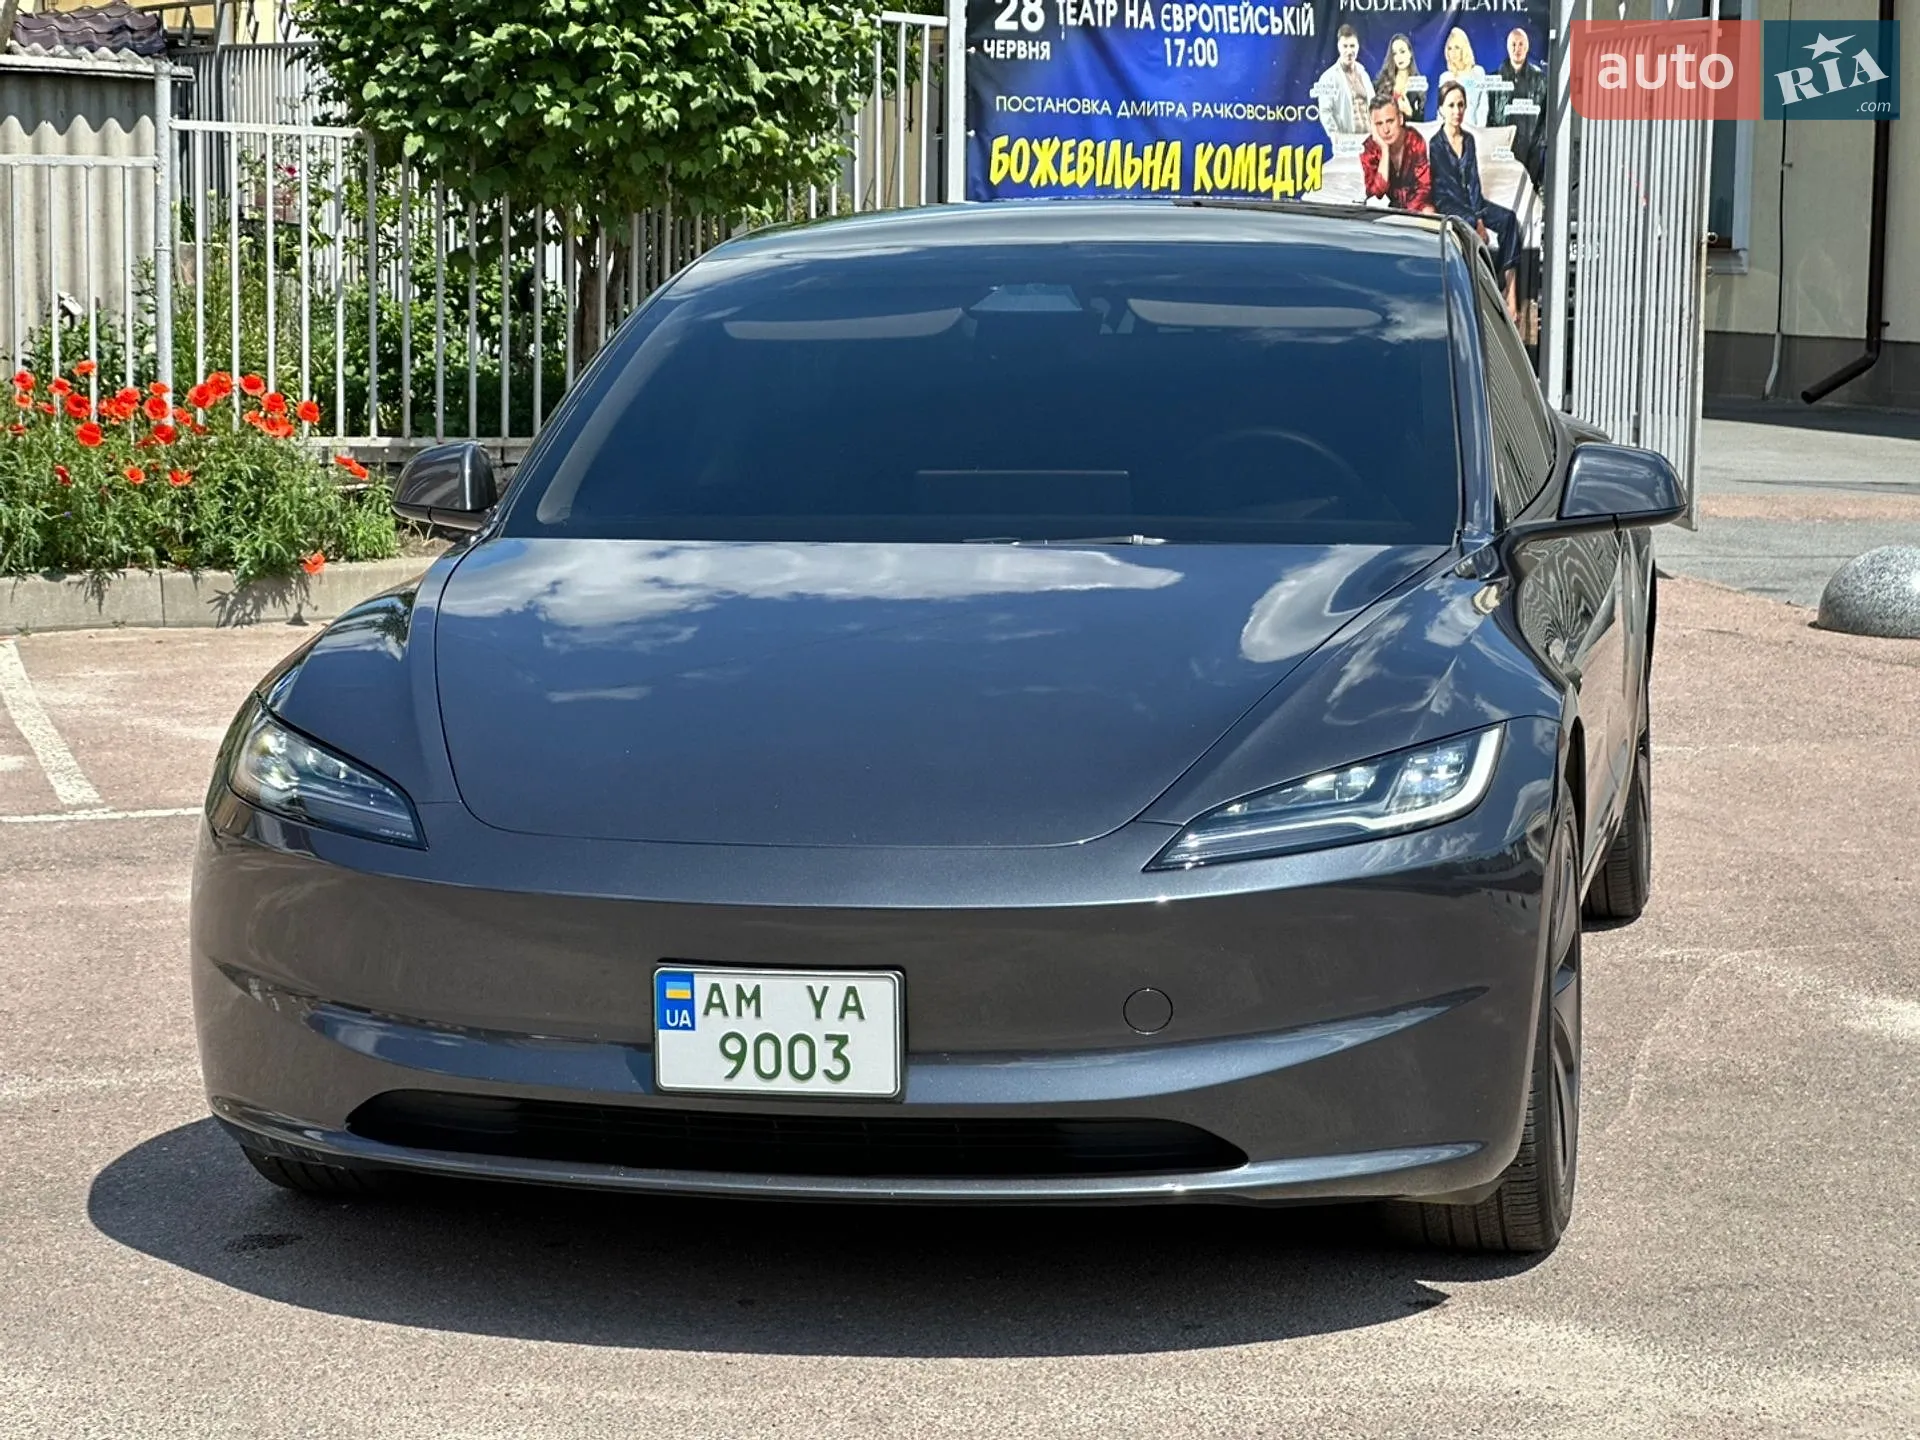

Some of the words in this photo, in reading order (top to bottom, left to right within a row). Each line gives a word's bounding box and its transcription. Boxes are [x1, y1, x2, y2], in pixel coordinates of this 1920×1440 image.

[994, 0, 1045, 32] 28
[1056, 0, 1118, 28] ТЕАТР
[1125, 0, 1156, 30] НА
[1160, 2, 1315, 37] ЄВРОПЕЙСЬКІЙ
[983, 39, 1051, 61] ЧЕРВНЯ
[1164, 38, 1219, 68] 17:00
[995, 95, 1113, 116] ПОСТАНОВКА
[1116, 101, 1188, 119] ДМИТРА
[1192, 103, 1320, 121] РАЧКОВСЬКОГО
[989, 135, 1182, 192] БОЖЕВІЛЬНА
[1193, 142, 1324, 201] КОМЕДІЯ
[702, 982, 762, 1019] AM
[806, 985, 866, 1021] YA
[665, 1009, 692, 1028] UA
[718, 1030, 853, 1083] 9003
